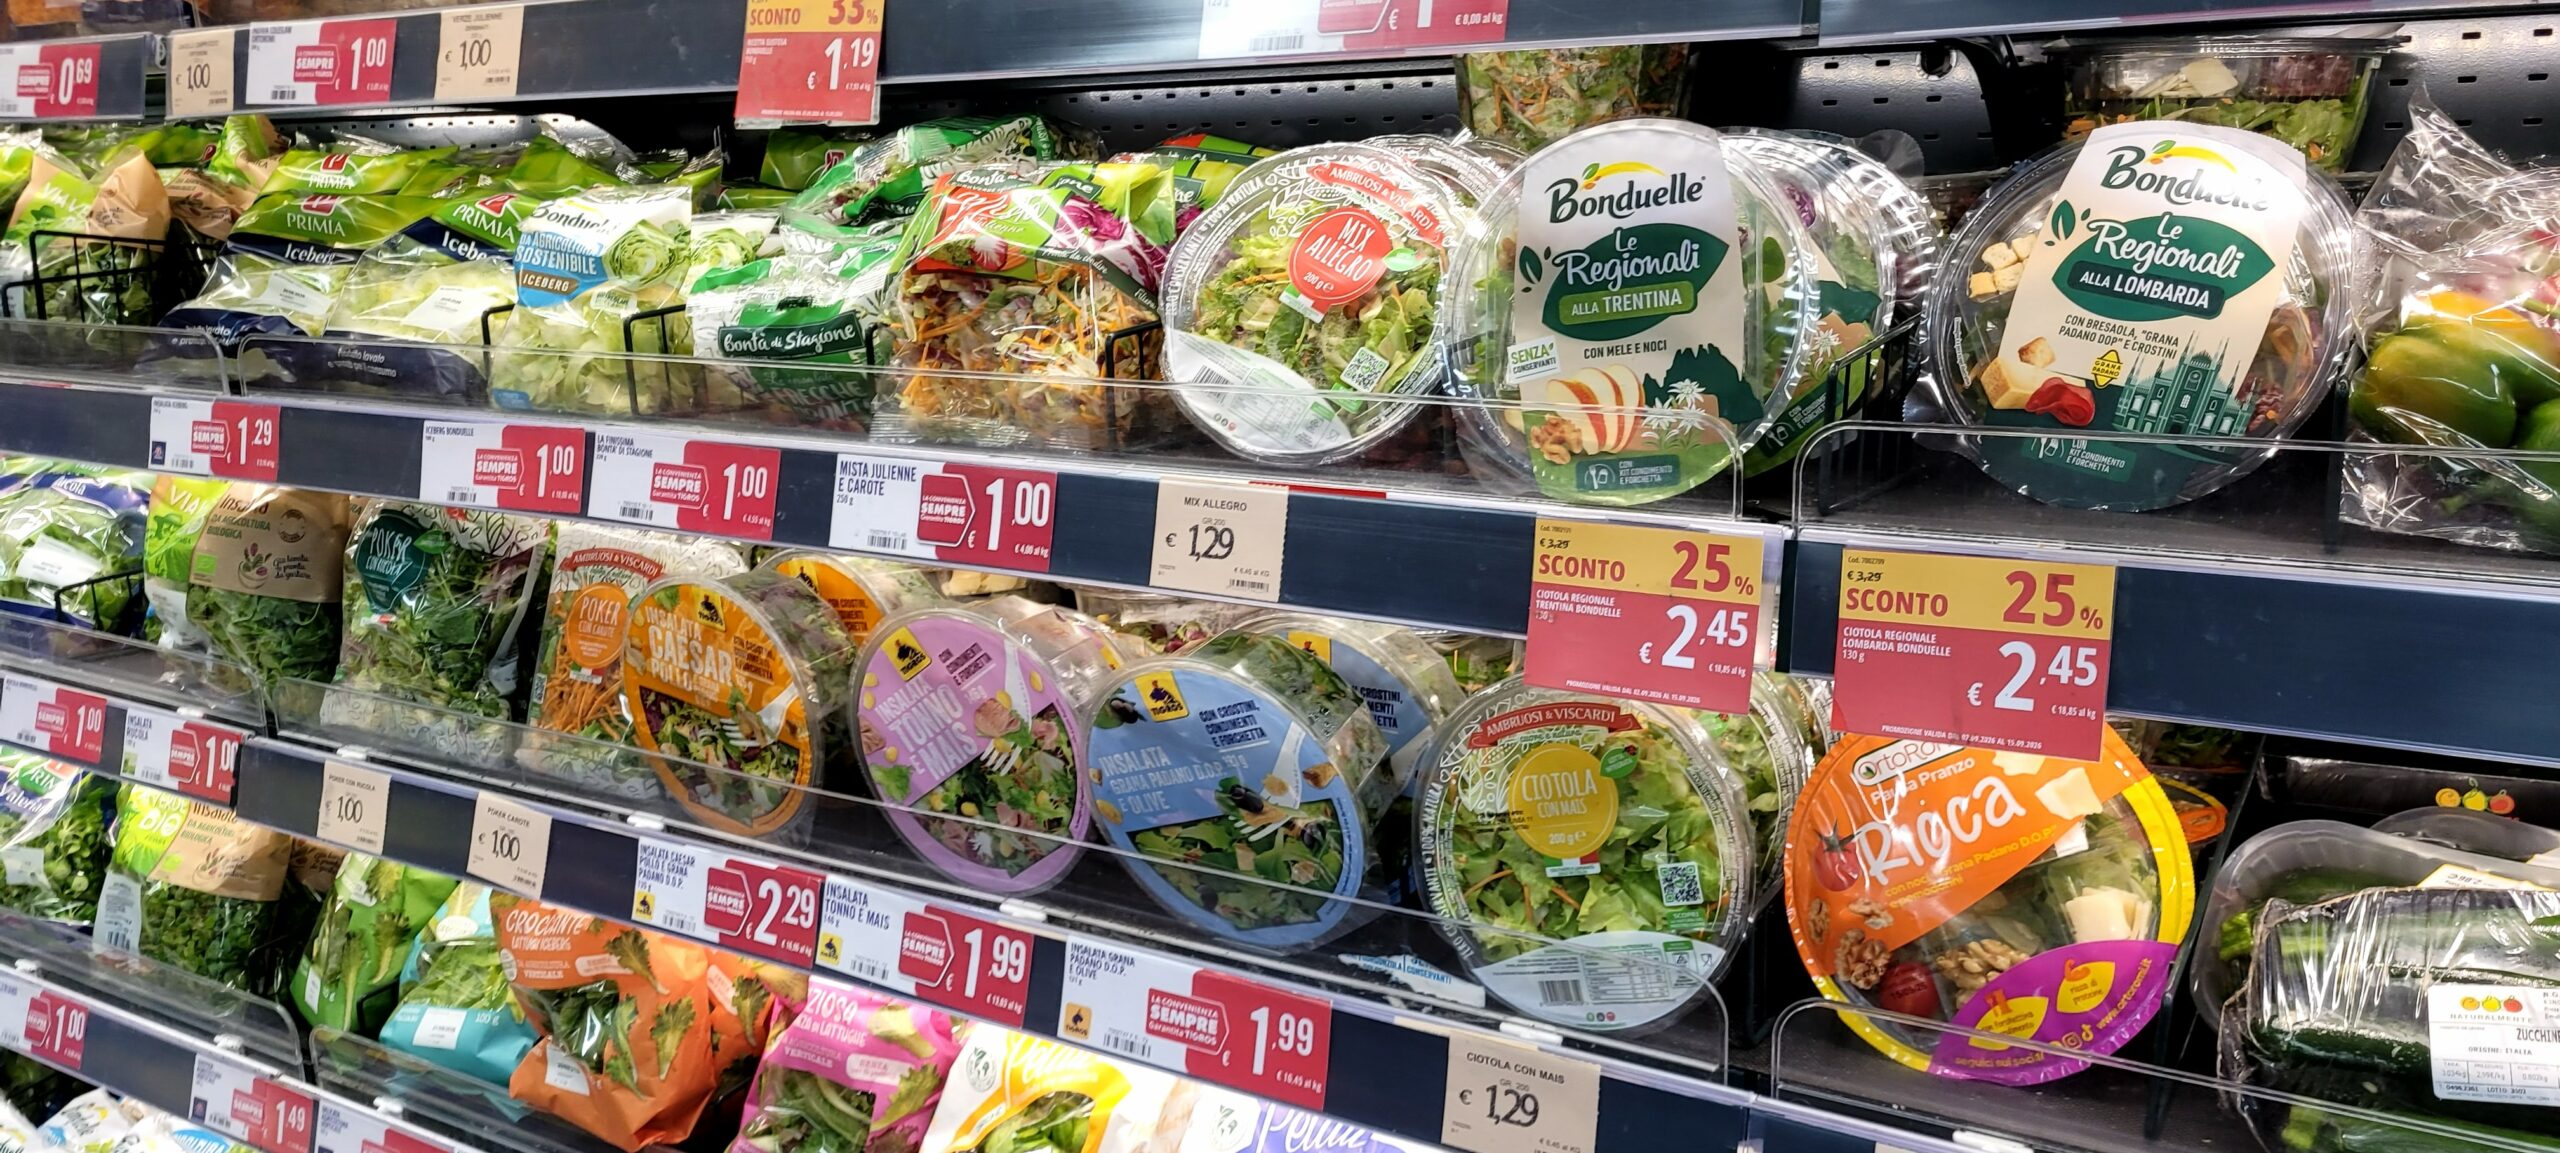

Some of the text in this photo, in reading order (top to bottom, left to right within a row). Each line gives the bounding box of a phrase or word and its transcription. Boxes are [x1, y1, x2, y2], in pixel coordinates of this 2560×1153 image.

[750, 8, 800, 26] SCONTO
[1388, 9, 1398, 31] €
[807, 71, 816, 90] €
[825, 37, 875, 90] 1,19
[1329, 167, 1382, 194] AMBRUOSI
[1544, 172, 1702, 224] Bonduelle
[287, 212, 345, 237] PRIMIA
[453, 204, 516, 243] PRIMIA
[1337, 217, 1376, 252] MIX
[2156, 214, 2183, 240] Le
[285, 243, 335, 265] Iceberg
[1614, 230, 1637, 252] Le
[2087, 220, 2245, 280] Regionali
[515, 245, 597, 275] SOSTENIBILE
[1305, 236, 1373, 283] ALLEGRO
[1555, 239, 1700, 292] Regionali
[523, 274, 570, 292] ICEBERG
[2079, 270, 2210, 309] ALLA LOMBARDA
[1571, 289, 1682, 316] ALLA TRENTINA
[784, 323, 856, 354] Stagione
[2064, 314, 2138, 343] CON BRESAOLA,
[1511, 346, 1549, 365] SENZA
[1584, 340, 1668, 360] CON MELE E NOCI
[2058, 325, 2178, 360] PADANO CROSTINI
[1512, 358, 1557, 375] CONSERVANTI
[2092, 366, 2120, 378] PADANO
[2094, 360, 2122, 373] GRANA
[476, 461, 519, 474] SEMPRE
[537, 444, 575, 498] 1,00
[839, 460, 917, 483] MISTA JULIENNE
[2070, 449, 2125, 469] KIT CONDIMENTO
[2072, 456, 2110, 474] FORCHETTA
[654, 476, 702, 493] SEMPRE
[702, 462, 768, 521] € 1,00
[847, 479, 885, 496] CAROTE
[921, 502, 966, 517] SEMPRE
[968, 478, 1050, 551] € 1,00
[1184, 496, 1248, 512] MIX ALLEGRO
[1165, 523, 1235, 562] € 1,29
[1539, 554, 1625, 582] SCONTO
[1535, 600, 1622, 618] TRENTINA BONDUELLE
[1536, 589, 1615, 607] CIOTOLA REGIONALE
[1845, 587, 1949, 617] SCONTO
[580, 598, 621, 626] POKER
[1639, 604, 1749, 670] € 2,45
[1842, 638, 1951, 657] LOMBARDA BONDUELLE
[1843, 626, 1937, 644] CIOTOLA REGIONALE
[648, 624, 733, 688] CAESAR
[1842, 649, 1858, 660] 130
[1967, 641, 2098, 711] € 2,45
[875, 678, 934, 726] INSALATA
[1150, 702, 1184, 716] TIGROS
[2058, 704, 2078, 717] 18,85
[888, 683, 965, 754] TONNO
[1486, 706, 1615, 736] AMBRUOSI VISCARDI
[1881, 725, 1946, 739] PROMOZIONE VALIDA
[918, 722, 978, 781] MAIS
[1098, 746, 1171, 776] INSALATA
[1109, 769, 1194, 795] GRANA PADANO
[1918, 757, 1975, 786] Pranzo
[1521, 769, 1598, 802] CIOTOLA
[337, 795, 363, 825] 1,00
[1130, 791, 1170, 815] OLIVE
[1537, 800, 1588, 819] CON MAIS
[491, 829, 521, 862] 1,00
[826, 883, 868, 907] INSALATA
[824, 899, 890, 930] TONNO MAIS
[945, 928, 1027, 999] € 1,99
[1069, 954, 1102, 971] PADANO
[1070, 943, 1136, 968] INSALATA GRANA
[1075, 967, 1097, 980] OLIVE
[1150, 1006, 1218, 1036] SEMPRE
[1160, 998, 1218, 1018] CONVENIENZA
[1185, 1029, 1217, 1046] TIGROS
[1221, 1006, 1314, 1076] € 1,99
[1466, 1051, 1565, 1085] CIOTOLA CON MAIS
[1459, 1084, 1540, 1127] € 1,29
